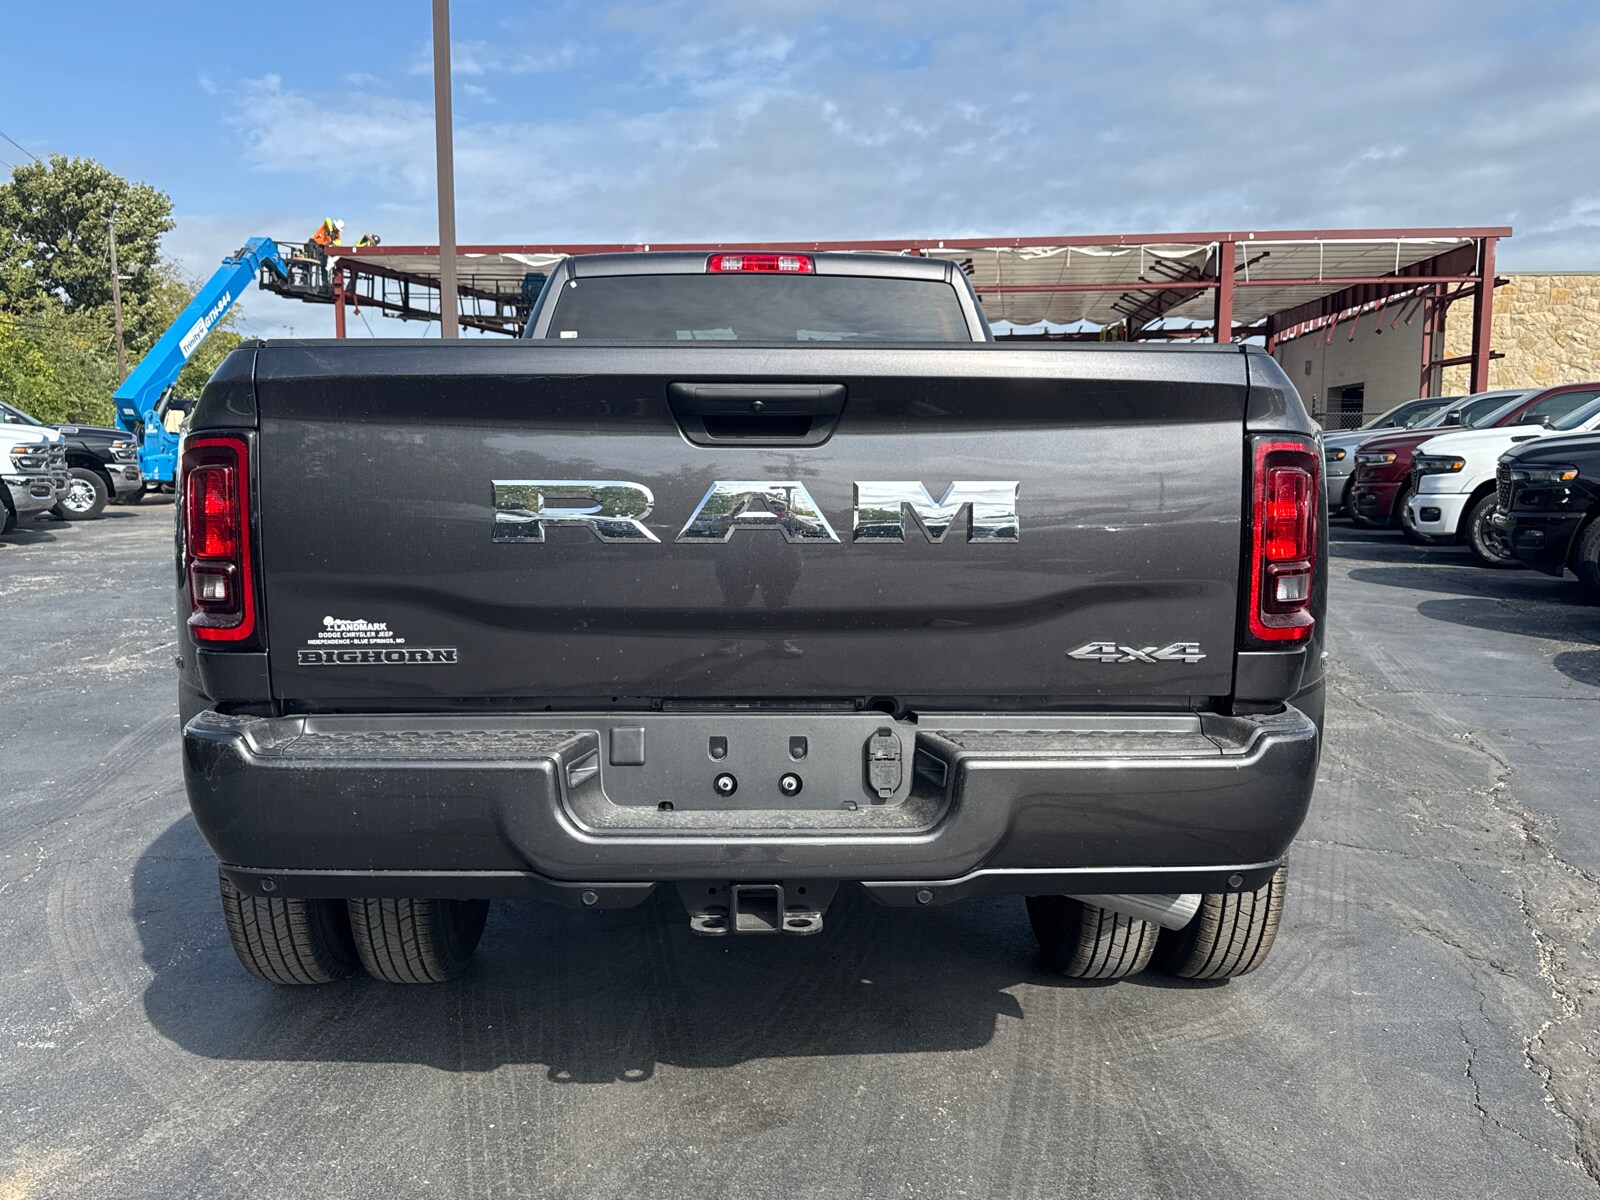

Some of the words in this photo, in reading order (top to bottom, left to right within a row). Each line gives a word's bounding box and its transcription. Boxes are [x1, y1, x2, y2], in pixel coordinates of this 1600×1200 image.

[182, 332, 201, 353] Trinity
[491, 480, 1020, 544] RAM
[333, 622, 388, 631] LANDMARK
[298, 648, 458, 665] BIGHORN
